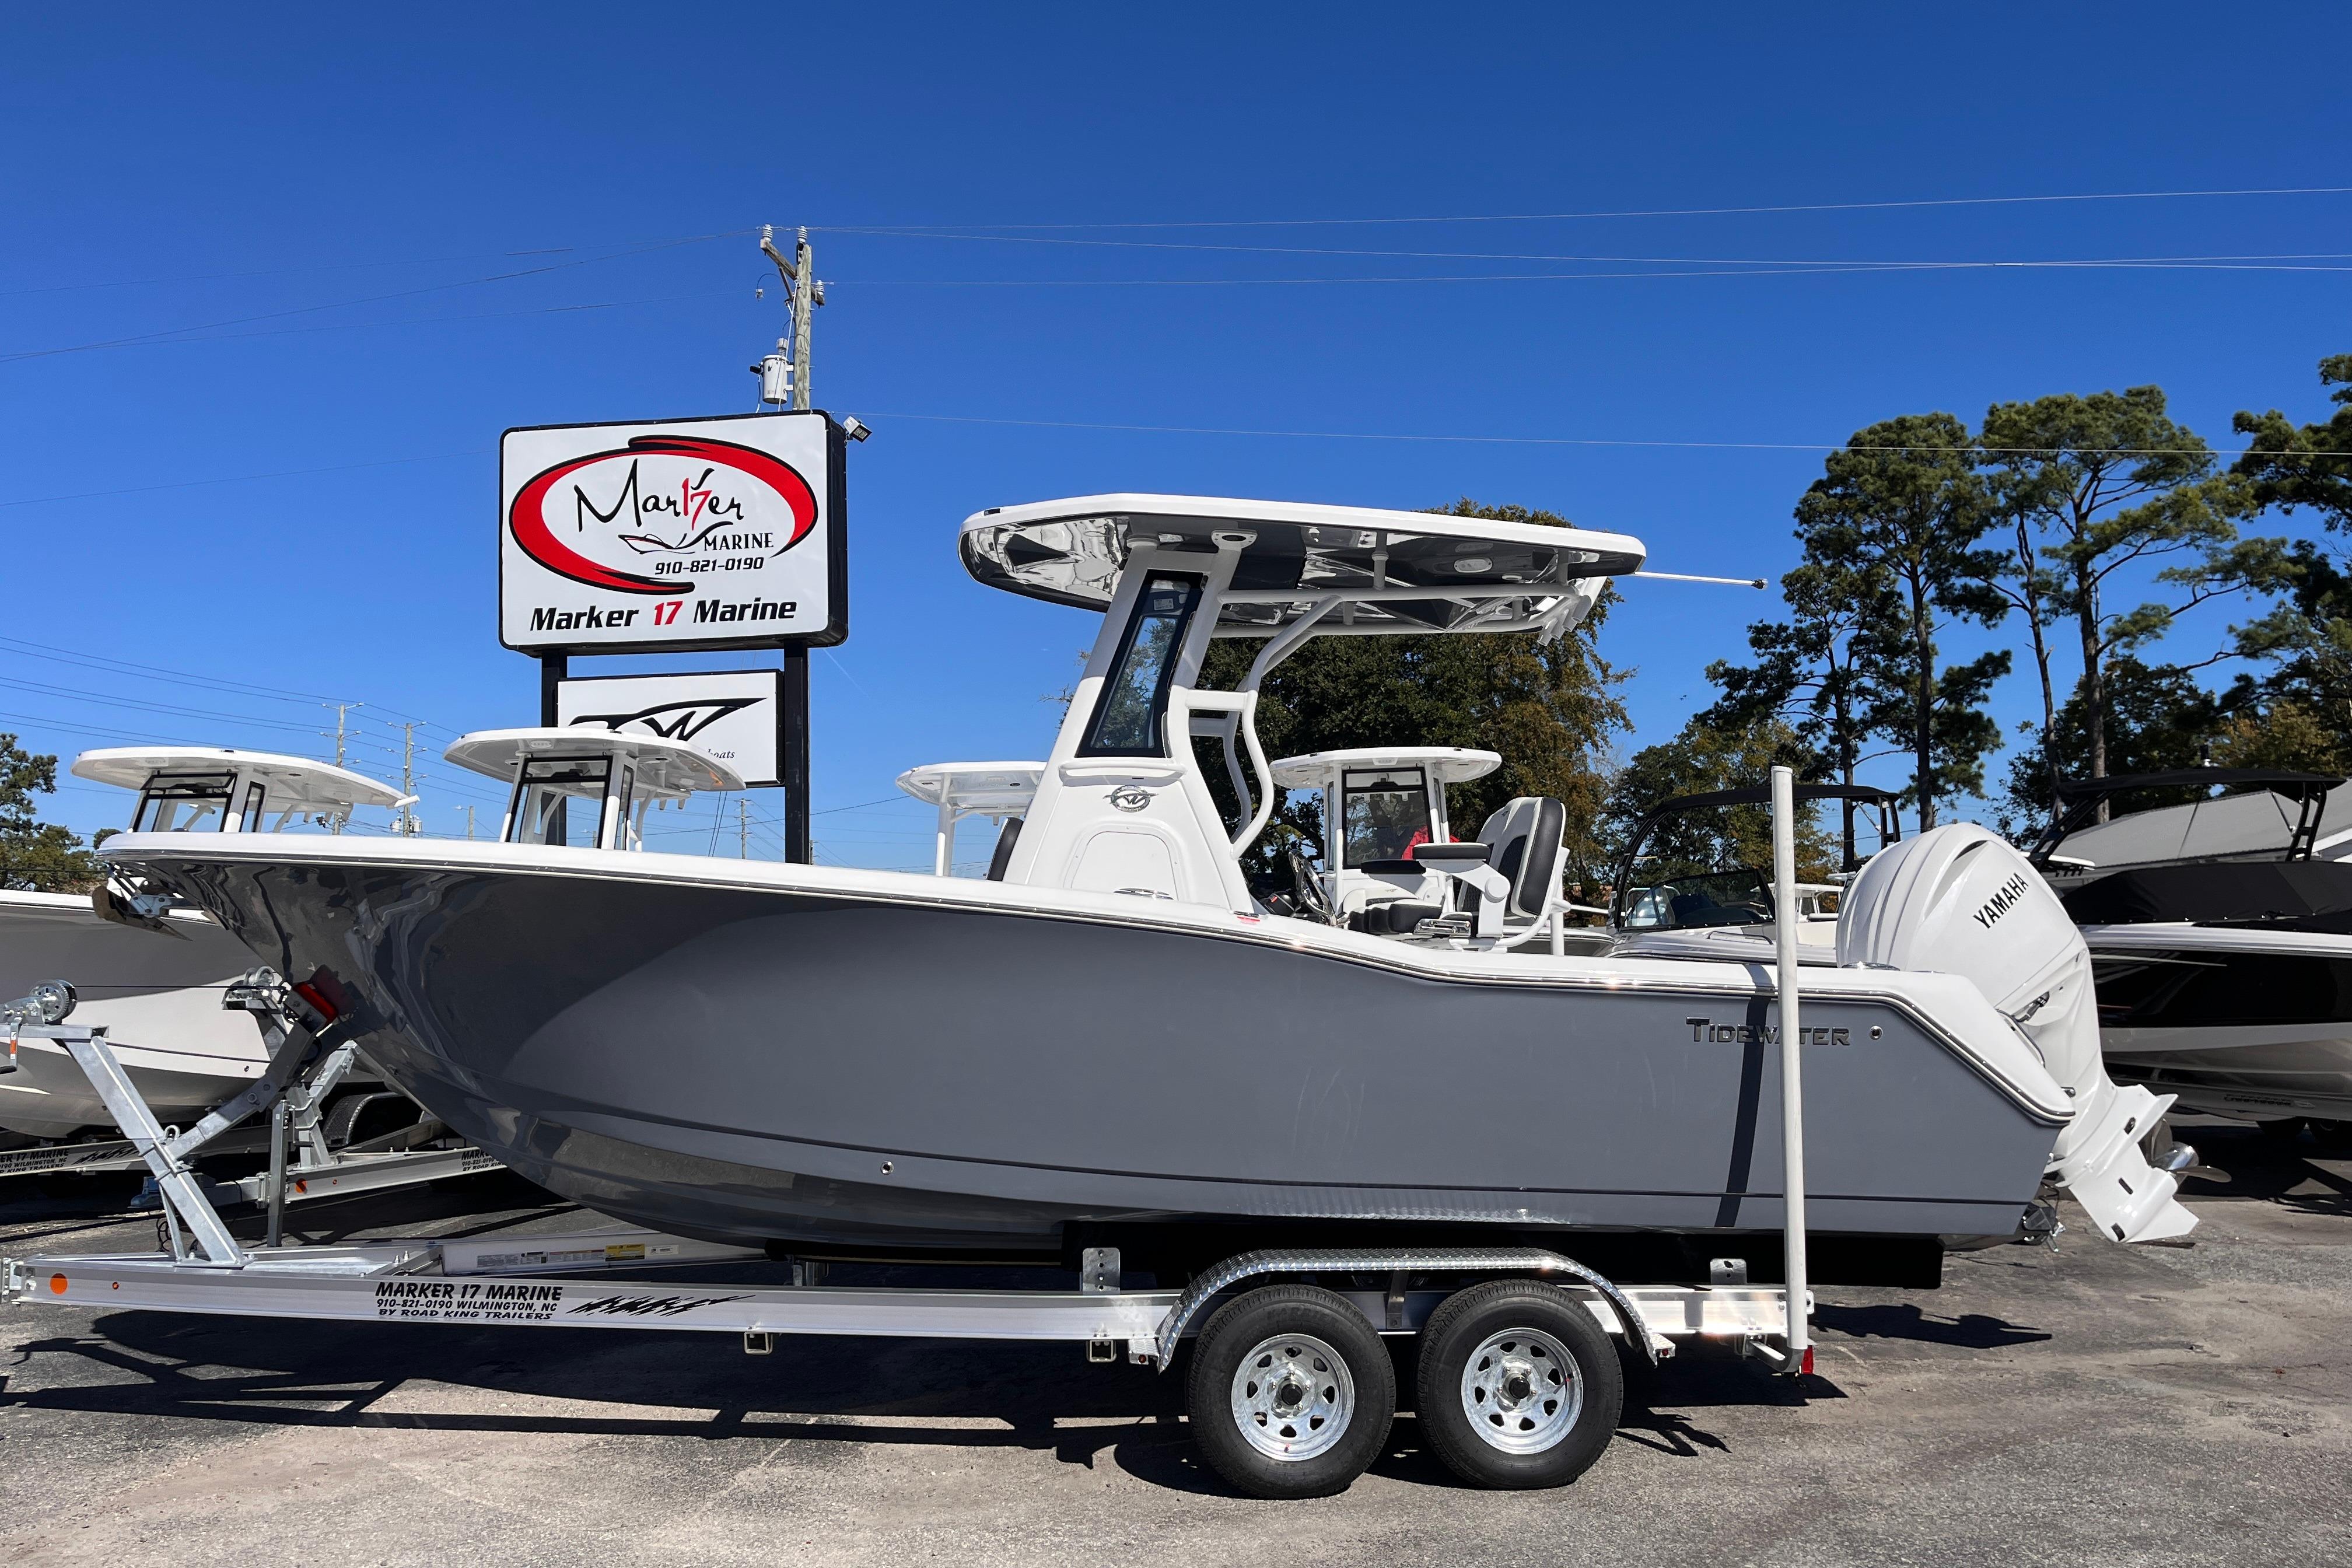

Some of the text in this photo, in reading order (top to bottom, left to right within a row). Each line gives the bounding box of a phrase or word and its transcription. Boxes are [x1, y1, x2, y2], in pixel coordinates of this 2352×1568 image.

[704, 532, 774, 551] MARINE
[654, 557, 764, 575] 910-821-0190
[530, 597, 797, 631] Marker 17 Marine
[1973, 873, 2028, 929] YAMAHA
[1686, 1016, 1850, 1046] TIDEWTER
[30, 1148, 70, 1160] MARINE
[375, 1282, 563, 1301] MARKER 17 MARINE
[377, 1298, 557, 1312] 910-821-0190 WILMINGTON, NC
[485, 1311, 553, 1320] TRAILERS
